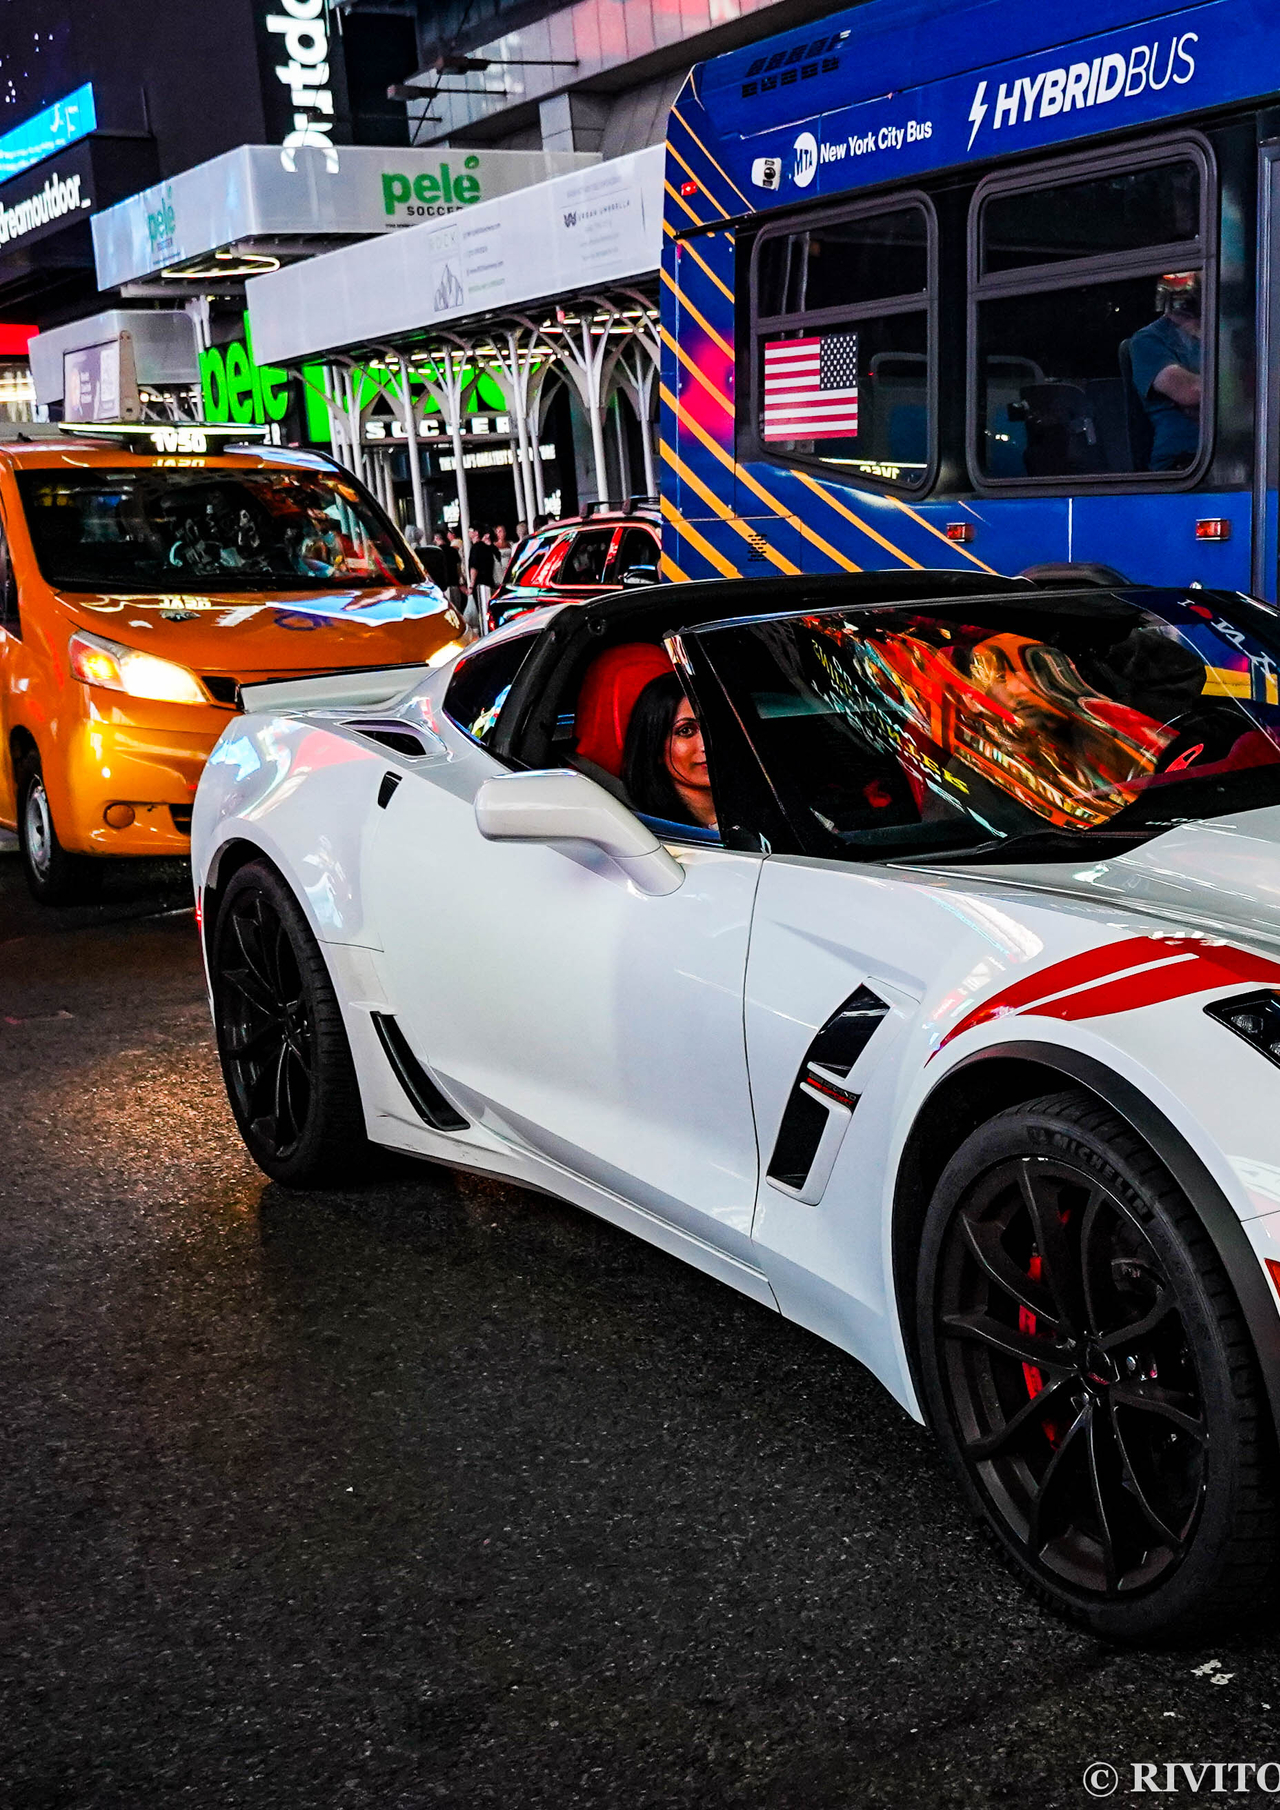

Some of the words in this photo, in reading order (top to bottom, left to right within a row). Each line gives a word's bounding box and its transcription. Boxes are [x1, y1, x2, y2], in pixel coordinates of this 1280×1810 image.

[820, 143, 847, 165] New
[848, 132, 876, 157] York
[877, 126, 905, 150] City
[906, 120, 932, 143] Bus
[381, 155, 480, 215] pelé
